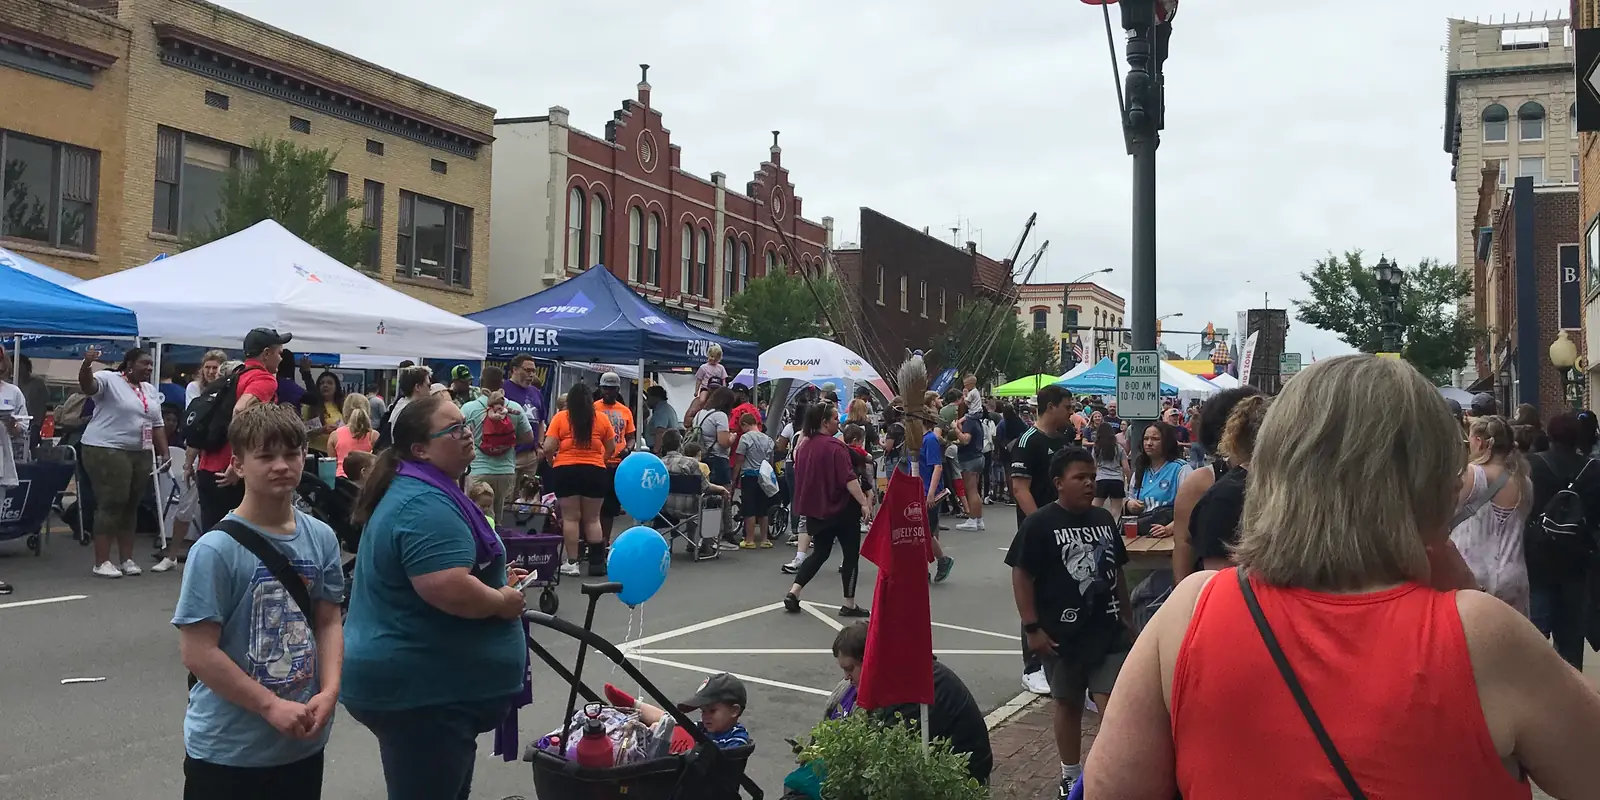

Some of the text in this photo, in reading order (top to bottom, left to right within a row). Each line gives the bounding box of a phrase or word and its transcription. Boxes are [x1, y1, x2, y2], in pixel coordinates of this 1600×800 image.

[1564, 268, 1580, 283] B
[536, 306, 588, 314] POWER
[494, 328, 559, 345] POWER
[686, 340, 714, 358] POW
[785, 358, 820, 366] ROWAN
[1119, 356, 1129, 373] 2
[1130, 365, 1157, 374] PARKING
[1125, 381, 1140, 390] 8:00
[1142, 381, 1151, 390] AM
[1121, 391, 1156, 400] TO 7:00 PM
[1053, 525, 1114, 546] MITSUKI
